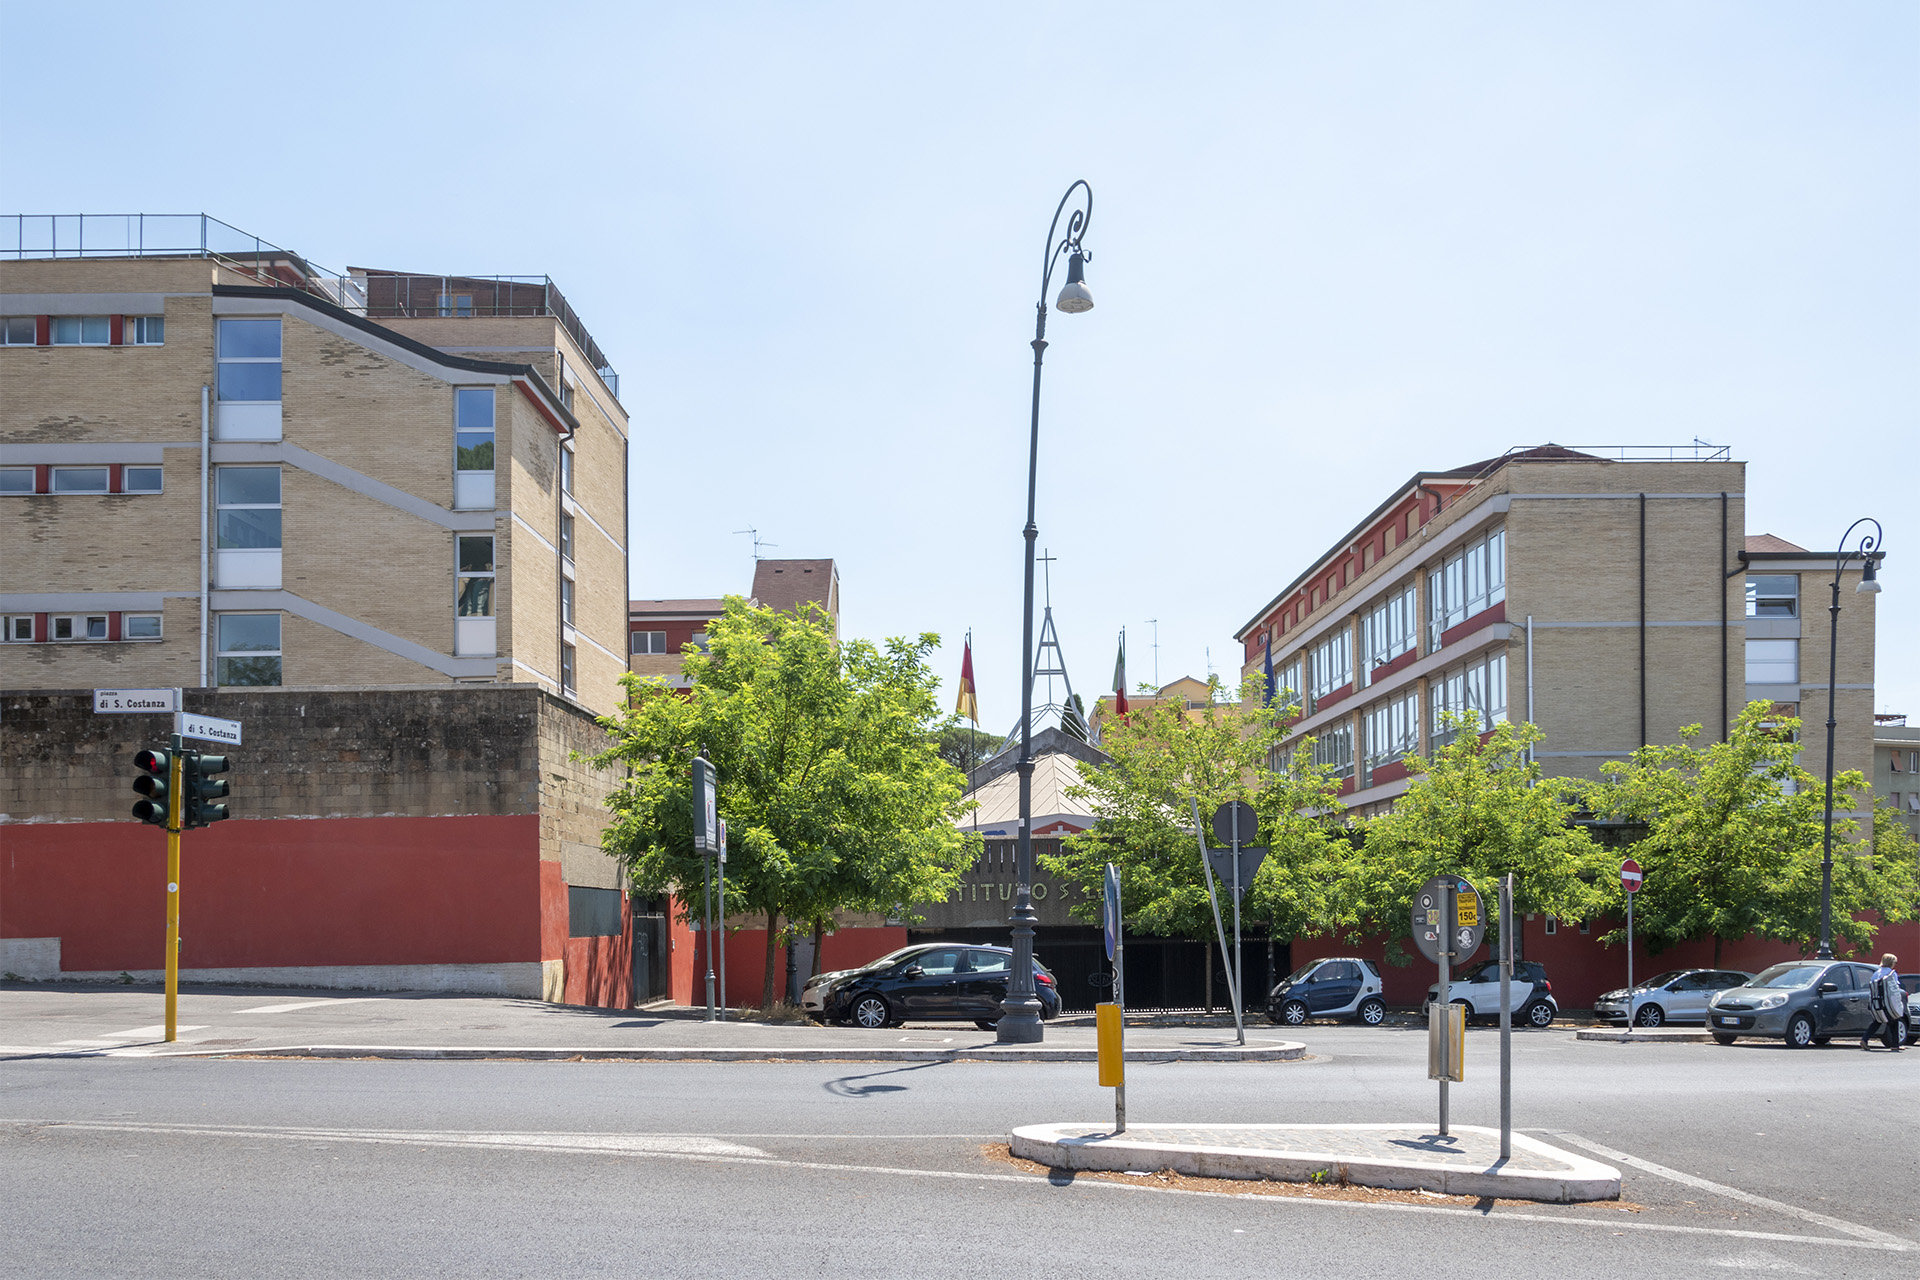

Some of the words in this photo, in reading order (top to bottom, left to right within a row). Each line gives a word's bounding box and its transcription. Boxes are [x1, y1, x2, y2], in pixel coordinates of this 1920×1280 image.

[100, 700, 108, 708] di
[114, 700, 123, 708] S.
[127, 700, 165, 708] Costanza
[188, 724, 195, 733] di
[199, 726, 206, 735] S.
[209, 728, 237, 740] Costanza
[1059, 883, 1077, 900] S.
